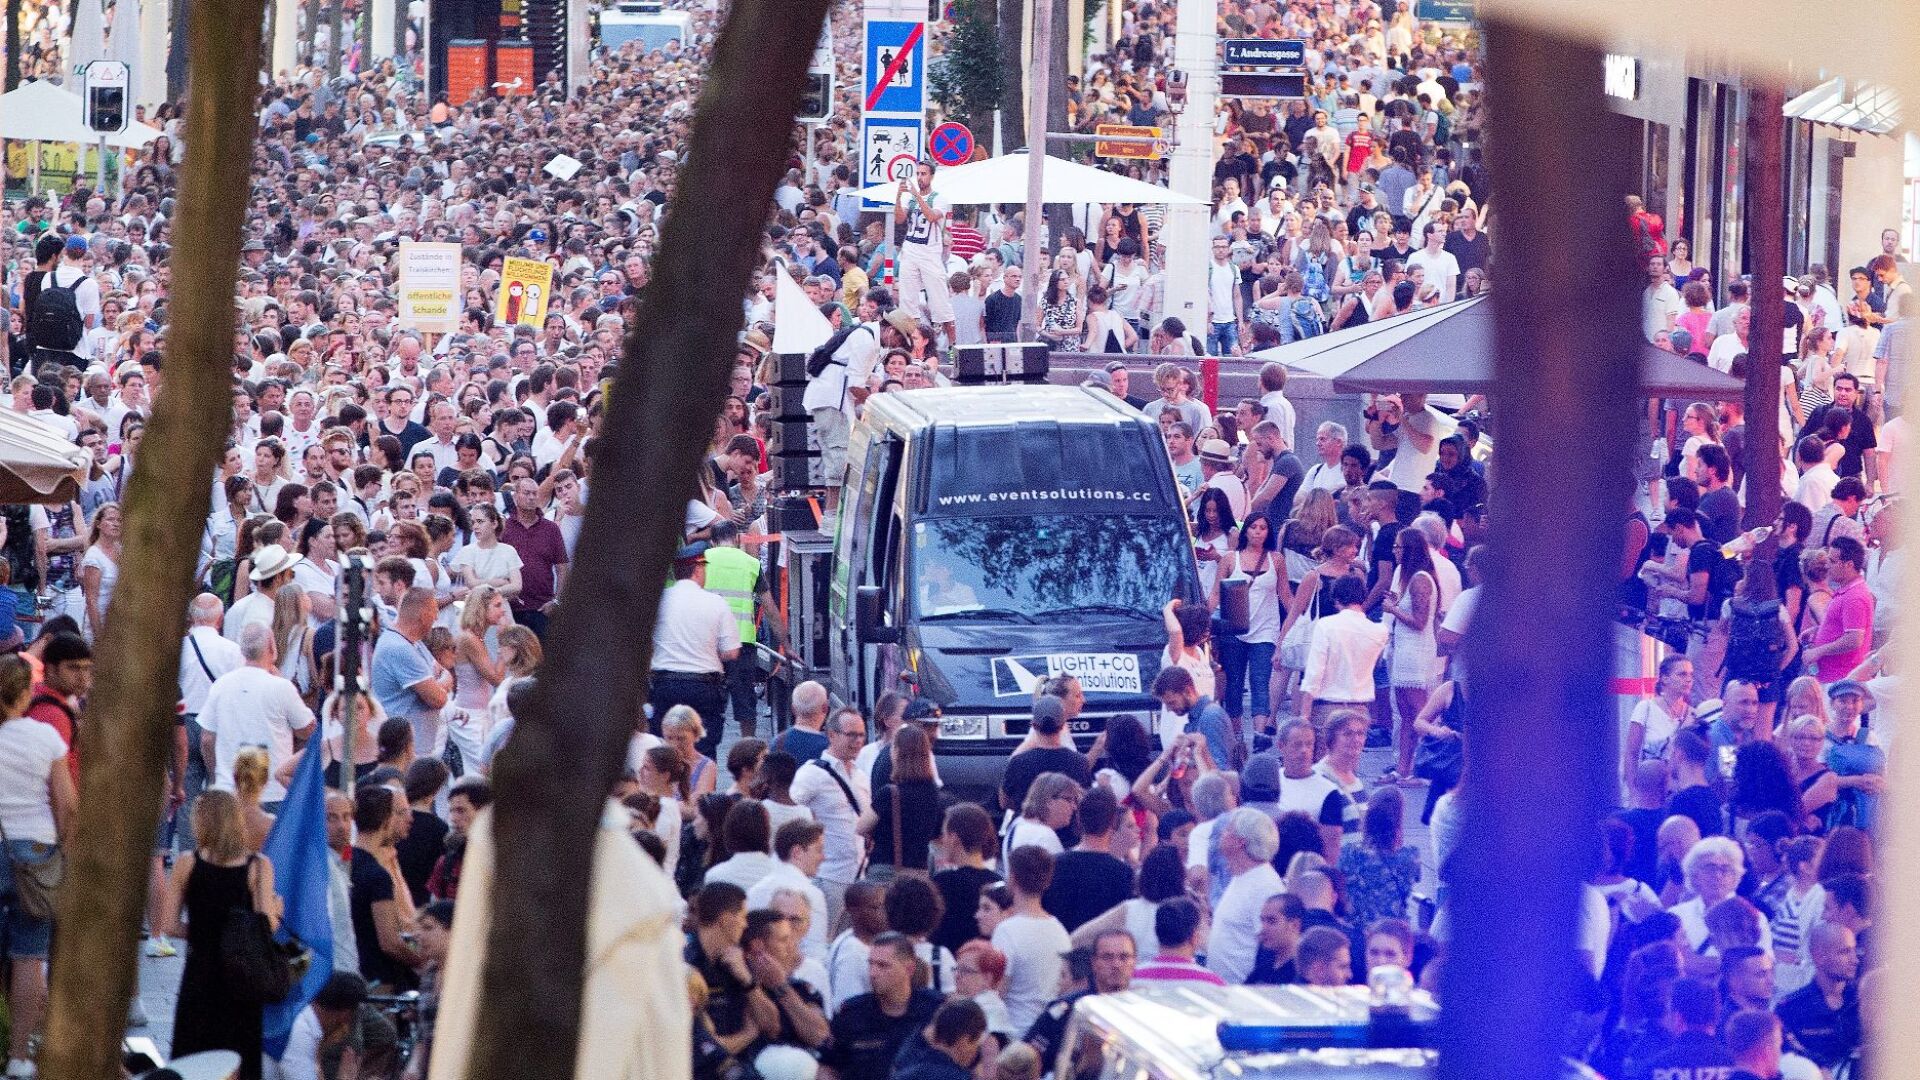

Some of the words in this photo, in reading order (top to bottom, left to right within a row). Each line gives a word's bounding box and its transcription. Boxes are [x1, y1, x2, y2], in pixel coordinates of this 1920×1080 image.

[1240, 47, 1300, 60] Andreasgasse
[896, 163, 913, 179] 20
[412, 305, 447, 314] Schande
[939, 488, 1151, 506] www.eventsolutions.cc
